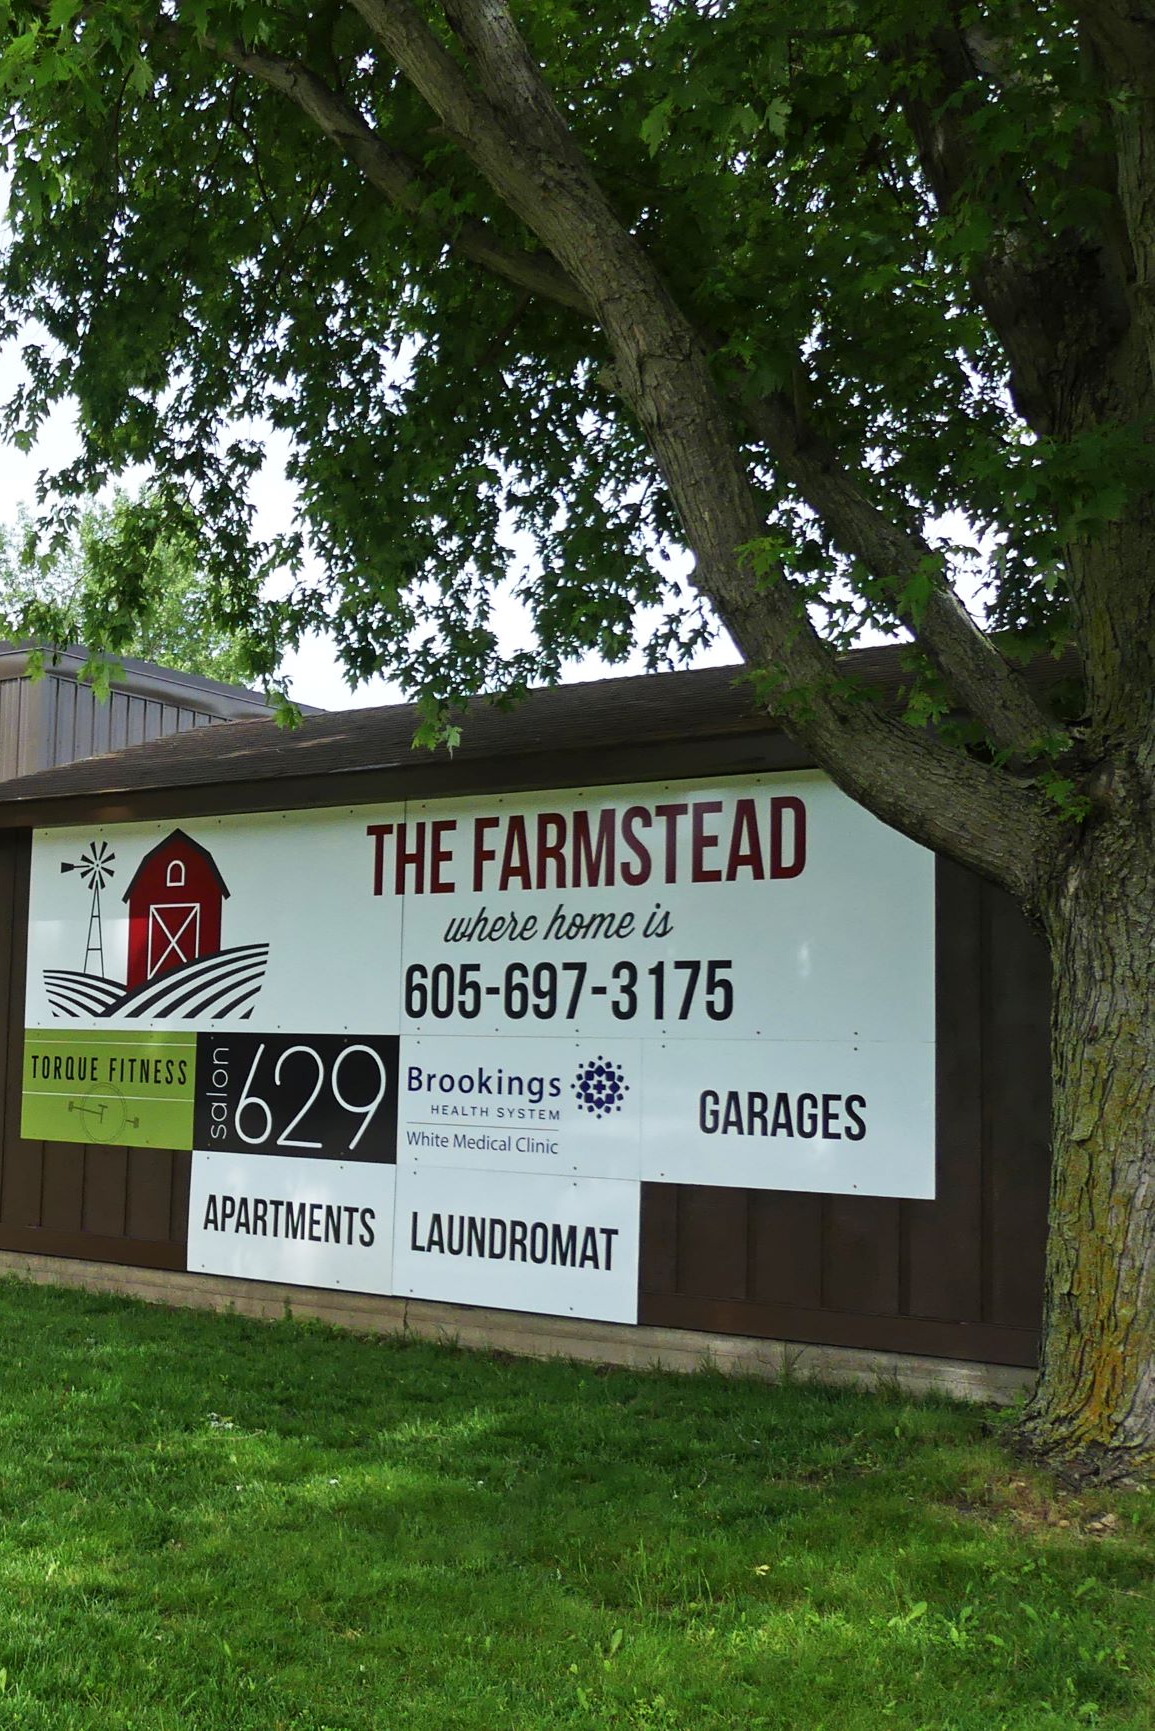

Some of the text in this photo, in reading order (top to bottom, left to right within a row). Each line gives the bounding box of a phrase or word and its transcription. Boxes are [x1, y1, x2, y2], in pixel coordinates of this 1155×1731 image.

[366, 795, 807, 896] THE FARMSTEAD
[443, 902, 674, 943] where home is
[404, 959, 734, 1021] 605-697-3175
[31, 1055, 188, 1086] TORQUE FITNESS
[206, 1046, 230, 1140] salon
[234, 1043, 387, 1150] 629
[407, 1066, 561, 1104] Brookings
[431, 1104, 561, 1121] HEALTH SYSTEM
[699, 1089, 867, 1141] GARAGES
[406, 1131, 559, 1155] White Medical Clinic
[203, 1194, 377, 1247] APARTMENTS
[410, 1211, 619, 1271] LAUNDROMAT
